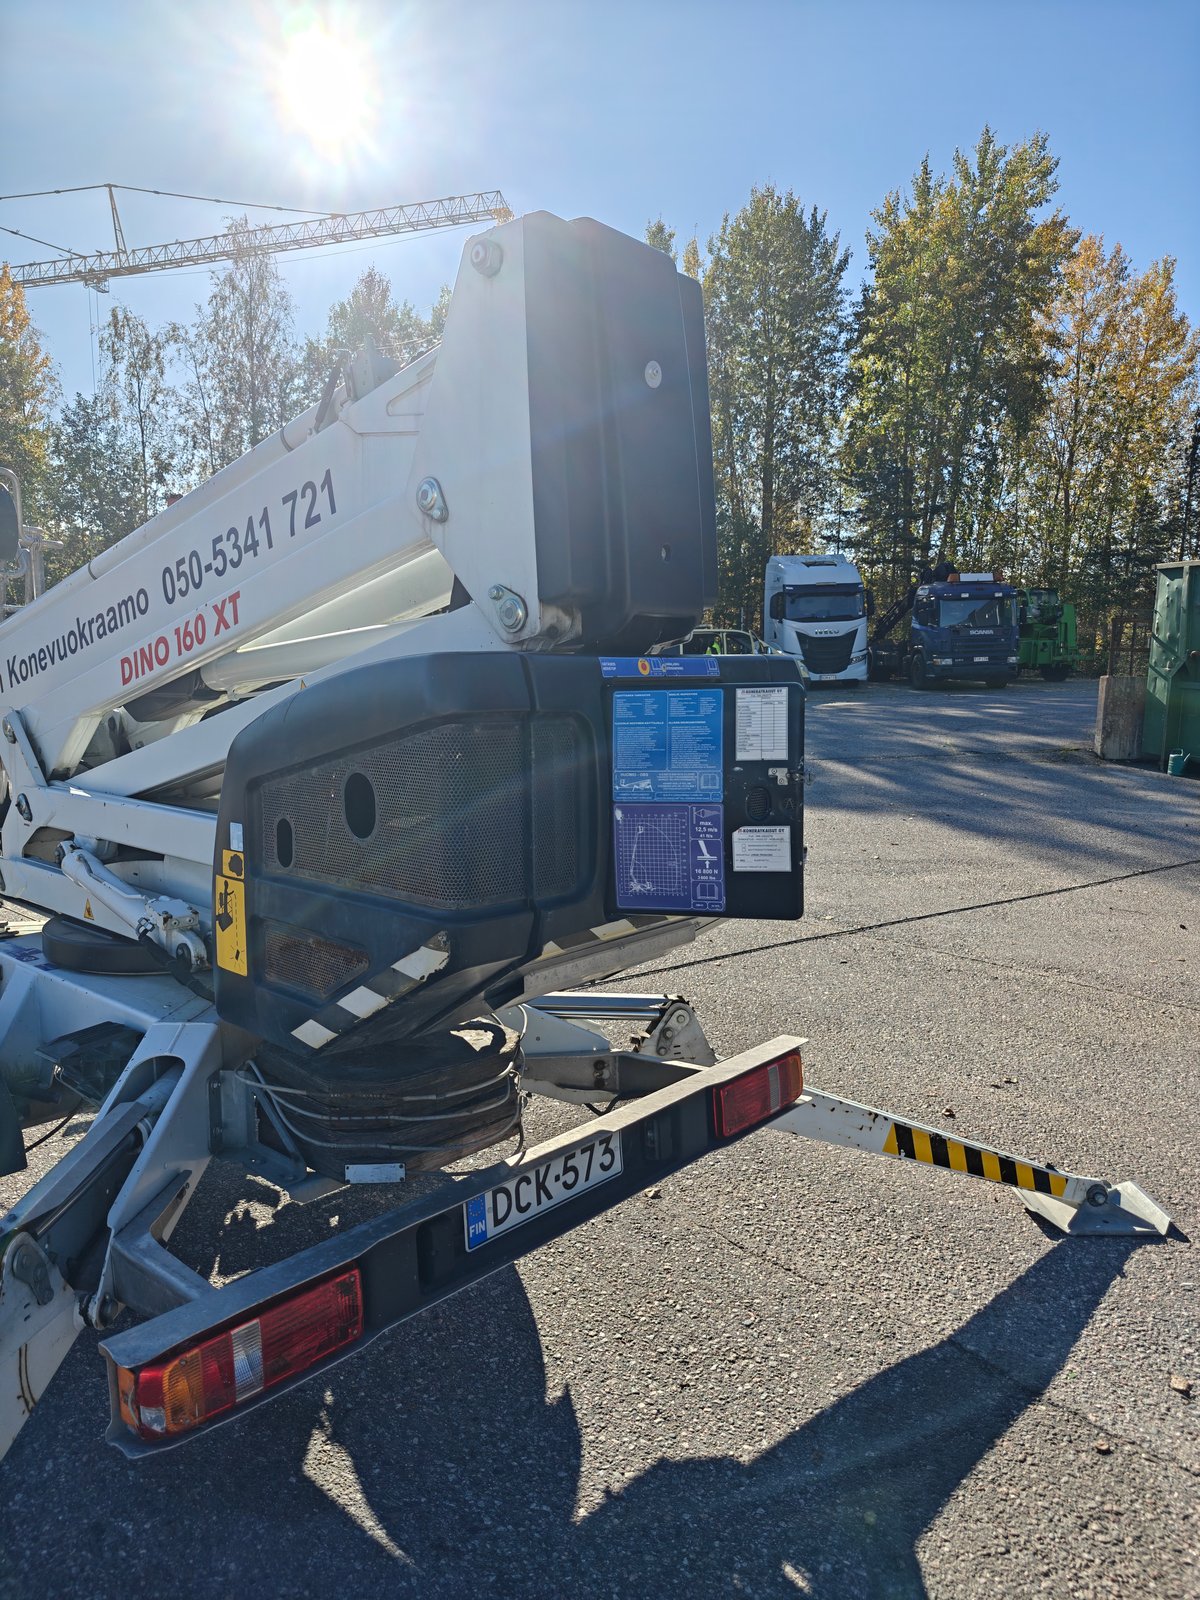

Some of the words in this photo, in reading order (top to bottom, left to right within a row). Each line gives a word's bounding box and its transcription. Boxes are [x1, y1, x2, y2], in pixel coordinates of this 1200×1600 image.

[6, 588, 149, 688] Konevuokraamo
[162, 506, 274, 605] 050-5341
[281, 468, 337, 537] 721
[120, 636, 170, 686] DINO
[174, 613, 207, 656] 160
[212, 590, 241, 637] XT
[491, 1134, 616, 1228] DCK-573
[469, 1220, 485, 1238] FIN
